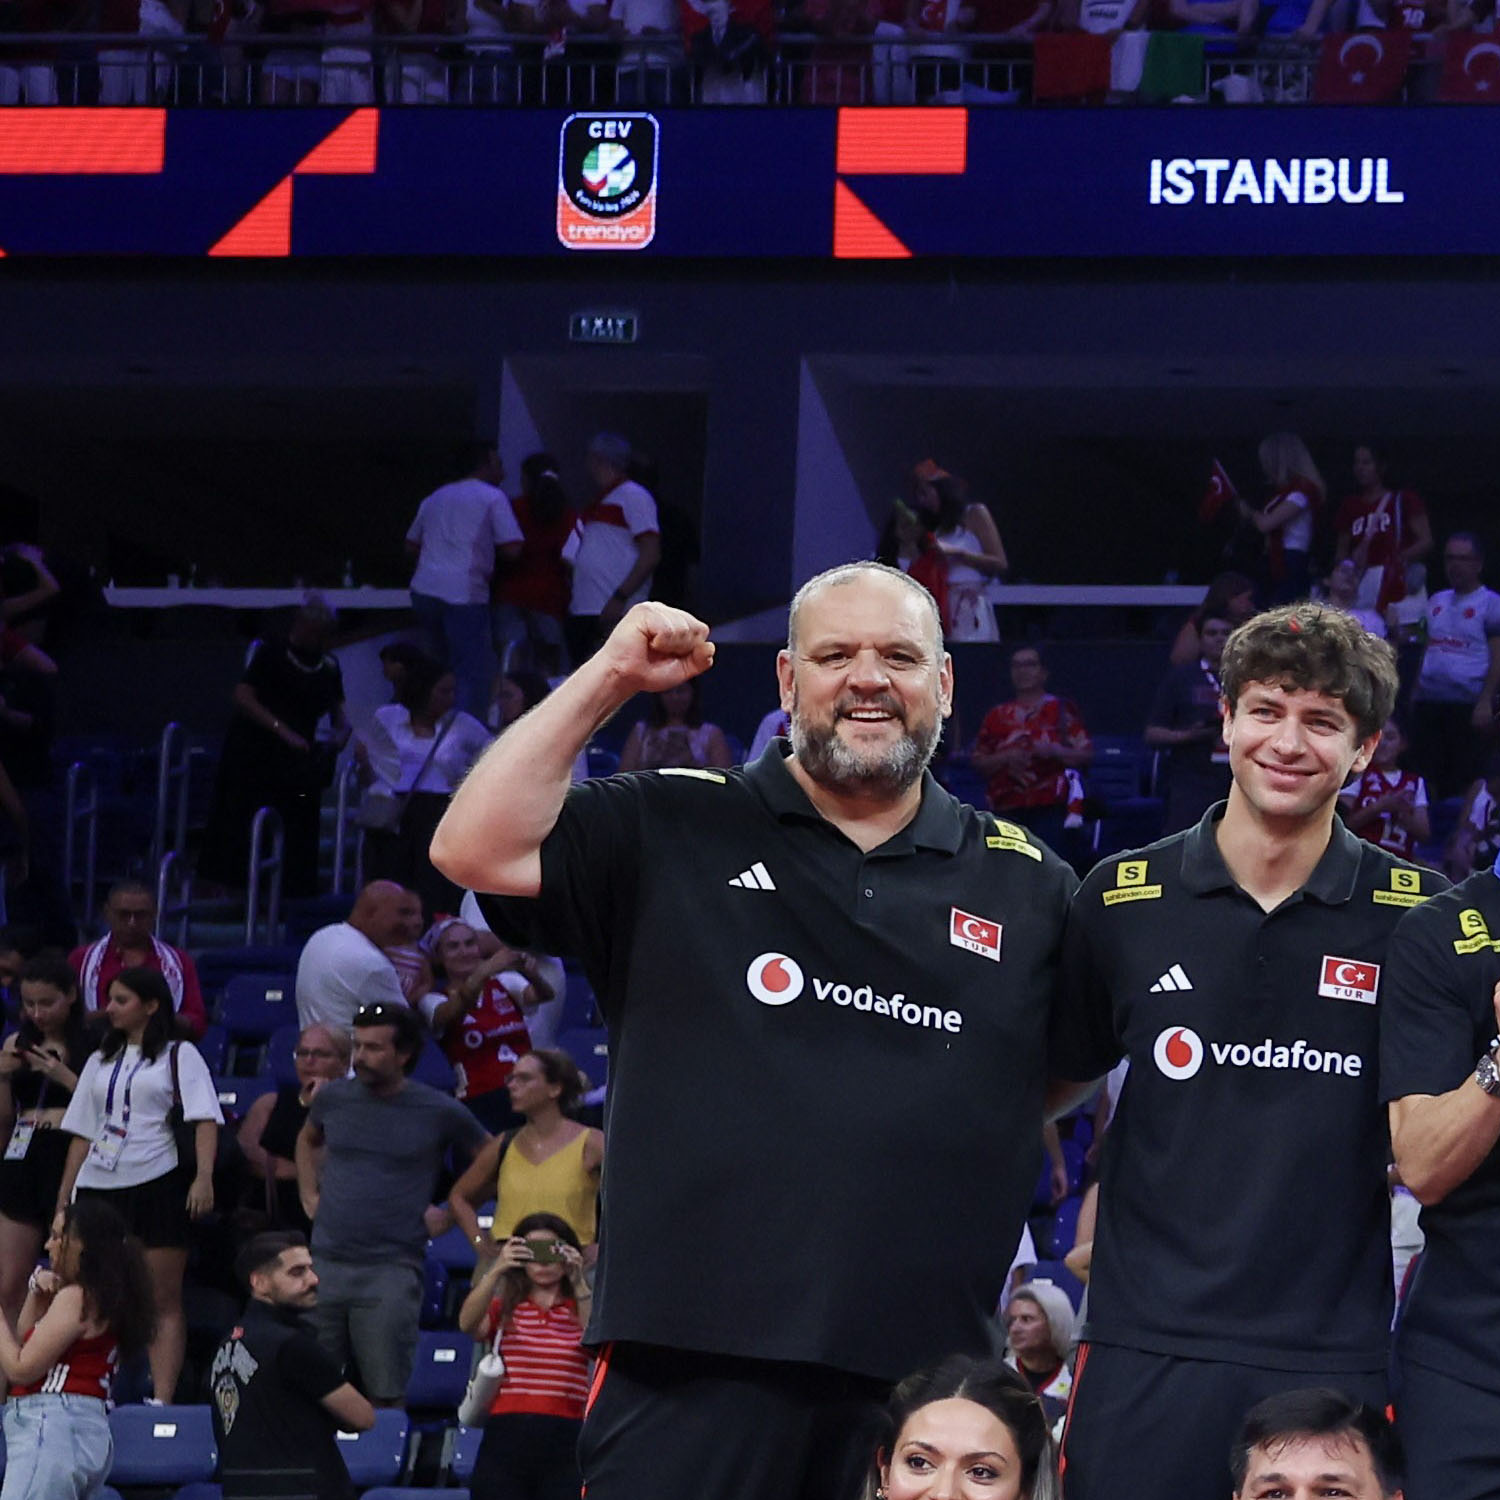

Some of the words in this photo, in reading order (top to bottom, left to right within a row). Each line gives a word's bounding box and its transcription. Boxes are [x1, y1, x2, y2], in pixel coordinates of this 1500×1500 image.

[589, 121, 633, 139] CEV
[1151, 160, 1403, 204] ISTANBUL
[1123, 865, 1140, 883] S
[1397, 869, 1414, 888] S
[1467, 911, 1484, 931] S
[1334, 988, 1364, 999] TUR
[812, 976, 964, 1034] vodafone
[1211, 1040, 1363, 1078] vodafone
